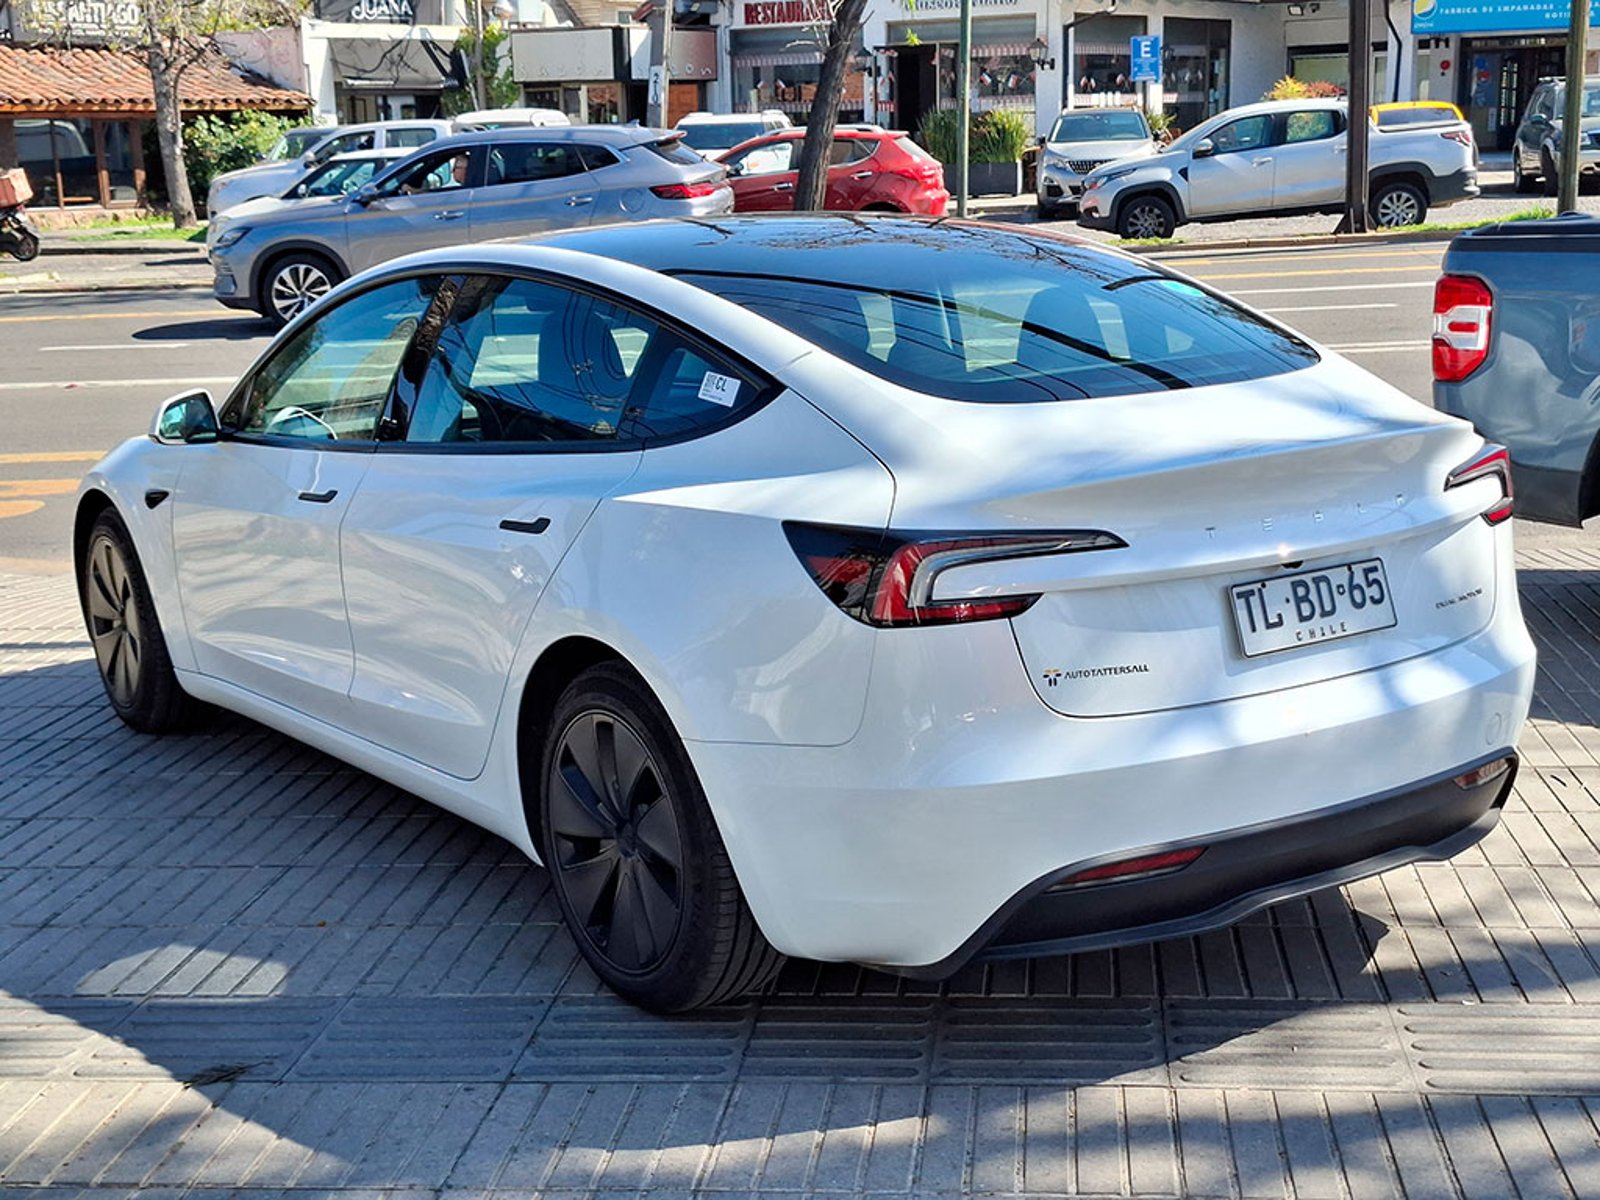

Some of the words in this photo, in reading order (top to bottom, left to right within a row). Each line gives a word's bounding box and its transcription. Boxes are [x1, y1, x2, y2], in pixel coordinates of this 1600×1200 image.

[744, 0, 832, 25] RESTAURA
[1140, 41, 1151, 57] E
[1295, 621, 1348, 642] CHILE
[1063, 664, 1150, 680] AUTOTATTERSALL
